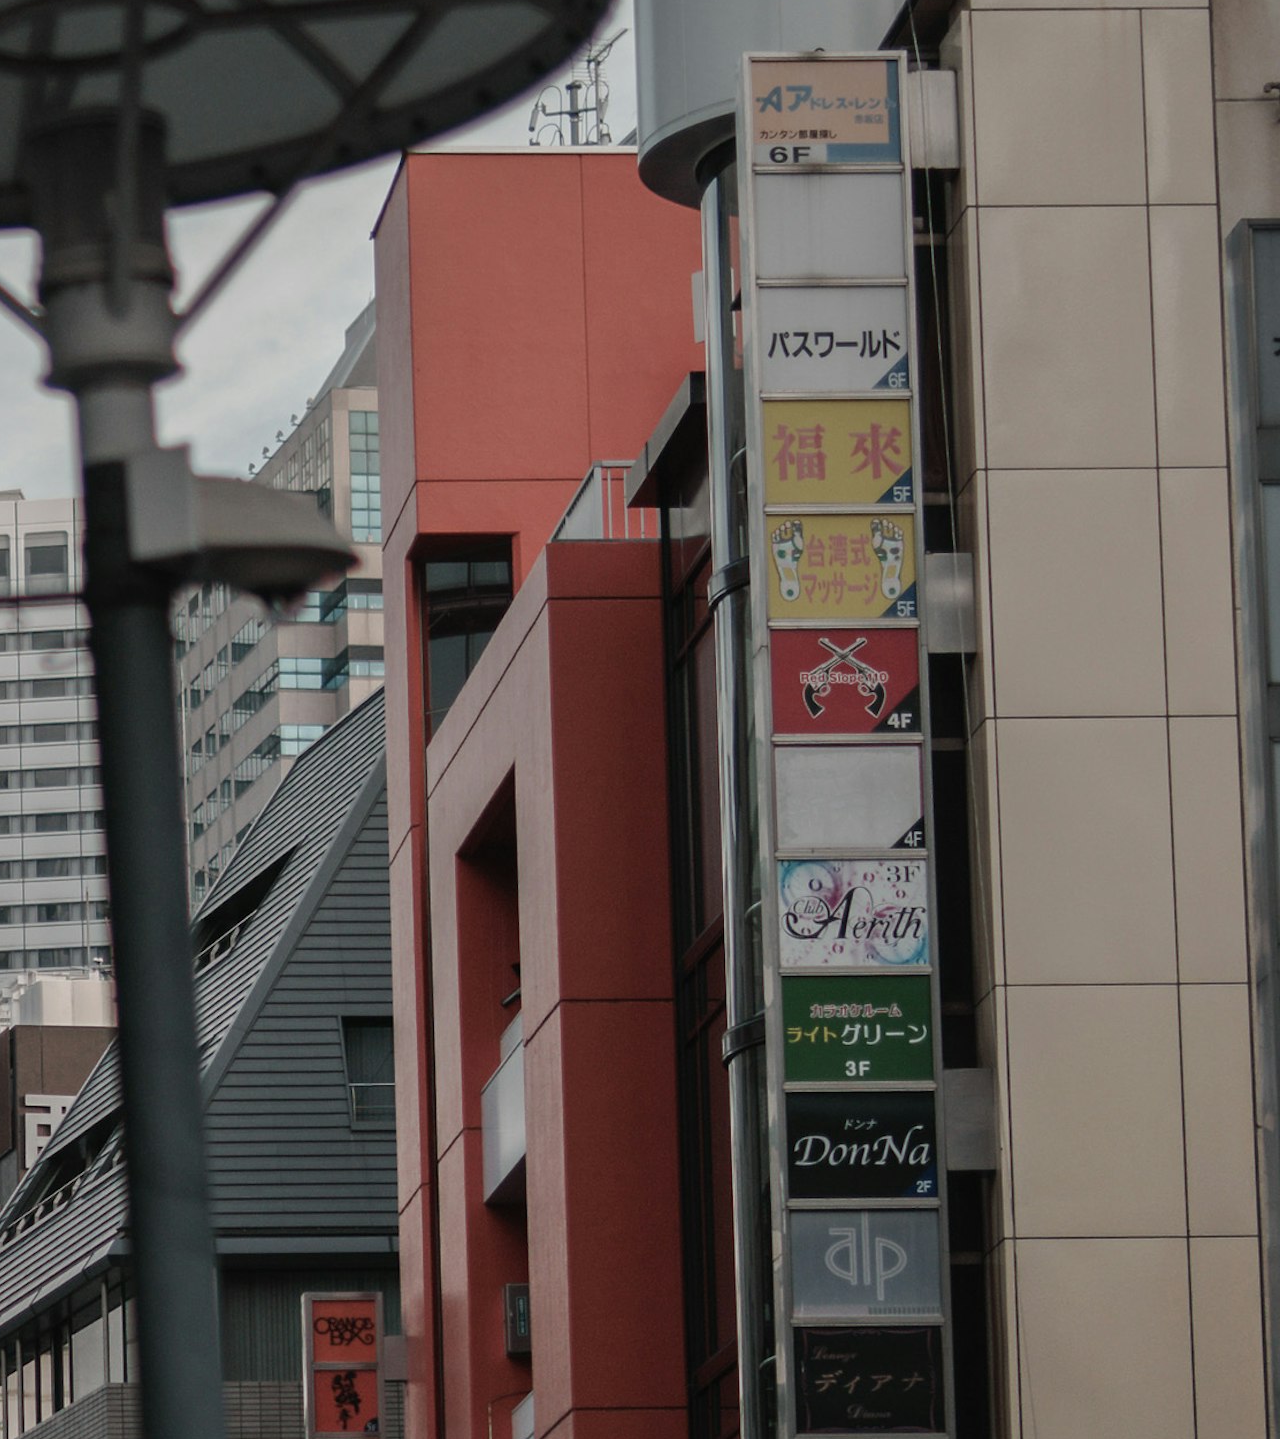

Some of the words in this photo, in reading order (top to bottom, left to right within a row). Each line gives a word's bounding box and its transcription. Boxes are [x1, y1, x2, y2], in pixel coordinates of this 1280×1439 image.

[759, 129, 838, 139] カンタン部屋探し
[769, 146, 811, 163] 6F
[768, 330, 901, 359] パスワールド
[888, 372, 906, 388] 6F
[892, 486, 911, 502] 5F
[806, 534, 871, 568] 台湾式
[801, 572, 879, 605] マッサージ
[897, 601, 915, 617] 5F
[887, 713, 913, 729] 4F
[904, 831, 923, 847] 4F
[887, 865, 921, 883] 3F
[782, 887, 926, 942] Aerith
[793, 900, 825, 915] Club
[810, 1003, 903, 1018] カラオケルーム
[786, 1024, 928, 1046] ライトグリーン
[845, 1060, 871, 1077] 3F
[843, 1117, 878, 1131] ドンナ
[793, 1126, 930, 1168] DonNa
[916, 1179, 932, 1194] 2F
[814, 1369, 926, 1395] ディアナ
